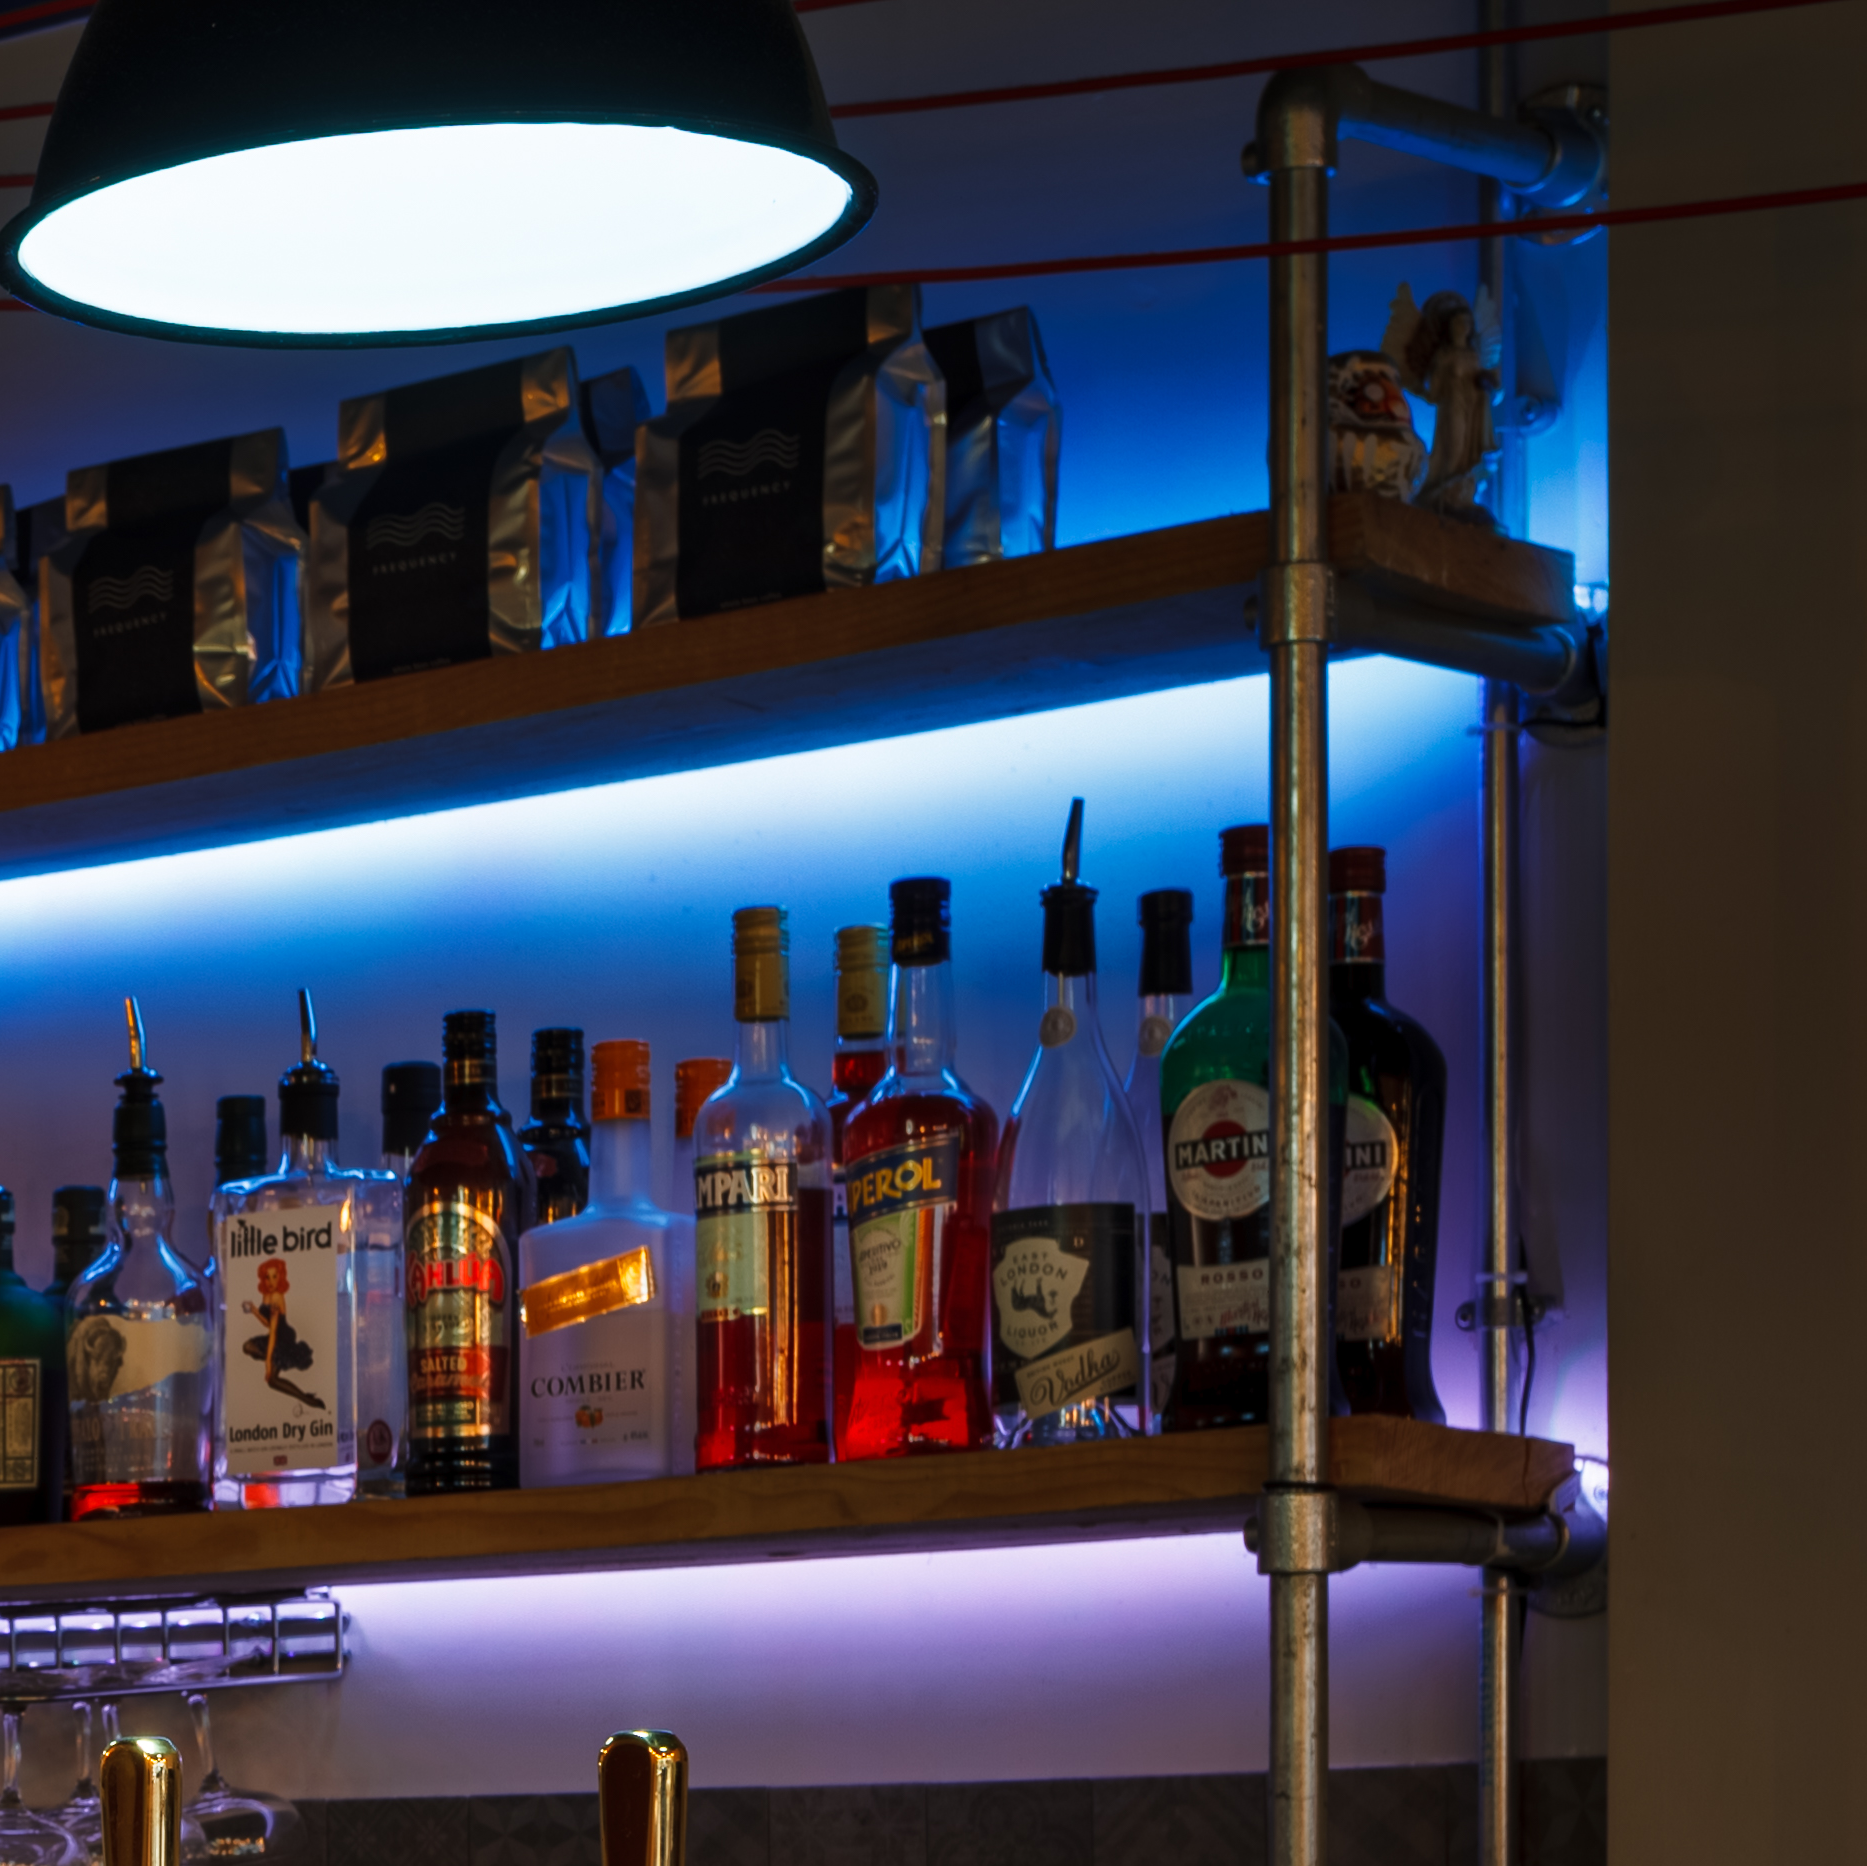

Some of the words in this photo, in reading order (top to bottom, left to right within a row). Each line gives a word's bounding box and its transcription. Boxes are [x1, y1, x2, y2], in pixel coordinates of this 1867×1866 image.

[1178, 1132, 1268, 1168] MARTIN
[230, 1219, 278, 1258] little
[282, 1221, 332, 1251] bird
[999, 1262, 1067, 1287] LONDON
[1201, 1267, 1264, 1286] ROSSO
[1006, 1320, 1059, 1339] LIQUOR
[420, 1355, 469, 1374] SALTED
[531, 1370, 645, 1399] COMBIER
[1030, 1349, 1122, 1406] Vodka
[229, 1425, 278, 1443] London
[282, 1422, 306, 1443] Dry
[310, 1419, 334, 1438] Gin
